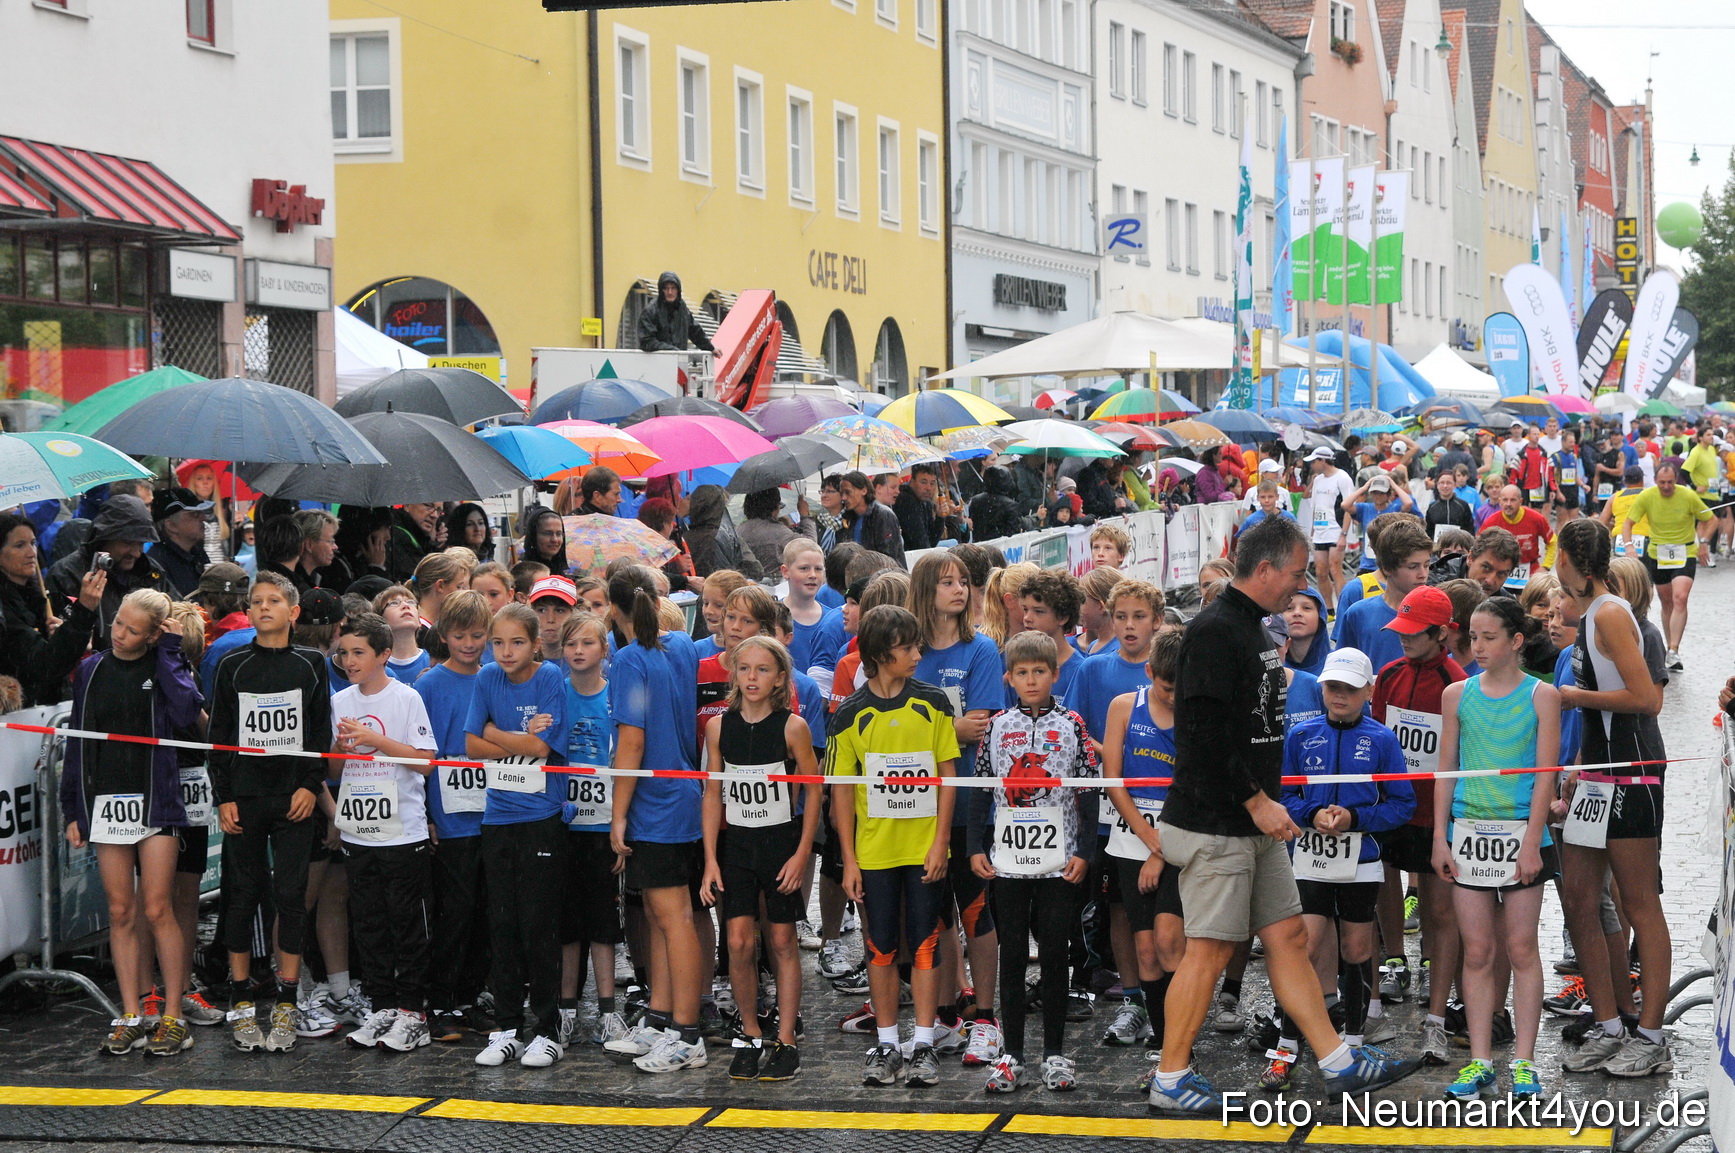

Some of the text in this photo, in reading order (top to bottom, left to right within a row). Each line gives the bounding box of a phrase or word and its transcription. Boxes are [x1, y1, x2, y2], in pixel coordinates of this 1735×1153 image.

[808, 249, 867, 295] CAFE DELI
[1616, 219, 1637, 307] HOT
[176, 266, 213, 283] GARDINEN
[260, 276, 276, 289] BABY
[284, 280, 327, 296] KINDERMODEN
[393, 301, 427, 325] FOTO
[442, 361, 487, 369] Duschen
[1633, 331, 1655, 393] Audi BKK
[14, 484, 41, 493] leben
[1669, 550, 1675, 559] 8
[246, 708, 298, 733] 4005
[1131, 723, 1157, 735] HEITEC
[247, 736, 296, 748] Maximilian
[1133, 747, 1150, 756] LAC
[447, 767, 487, 790] 409
[498, 771, 525, 784] Leonie
[182, 781, 208, 806] 081
[567, 779, 606, 804] 083
[729, 781, 780, 805] 4001
[101, 800, 145, 823] 400
[341, 797, 391, 821] 4020
[741, 809, 768, 819] Ulrich
[888, 799, 915, 809] Daniel
[1574, 798, 1607, 824] 4097
[107, 826, 146, 836] Michelle
[356, 825, 380, 834] Jonas
[1002, 824, 1057, 850] 4022
[1297, 831, 1351, 859] 4031
[1459, 836, 1520, 863] 4002
[1015, 855, 1041, 865] Lukas
[1312, 859, 1327, 869] Nic
[1471, 866, 1506, 878] Nadine
